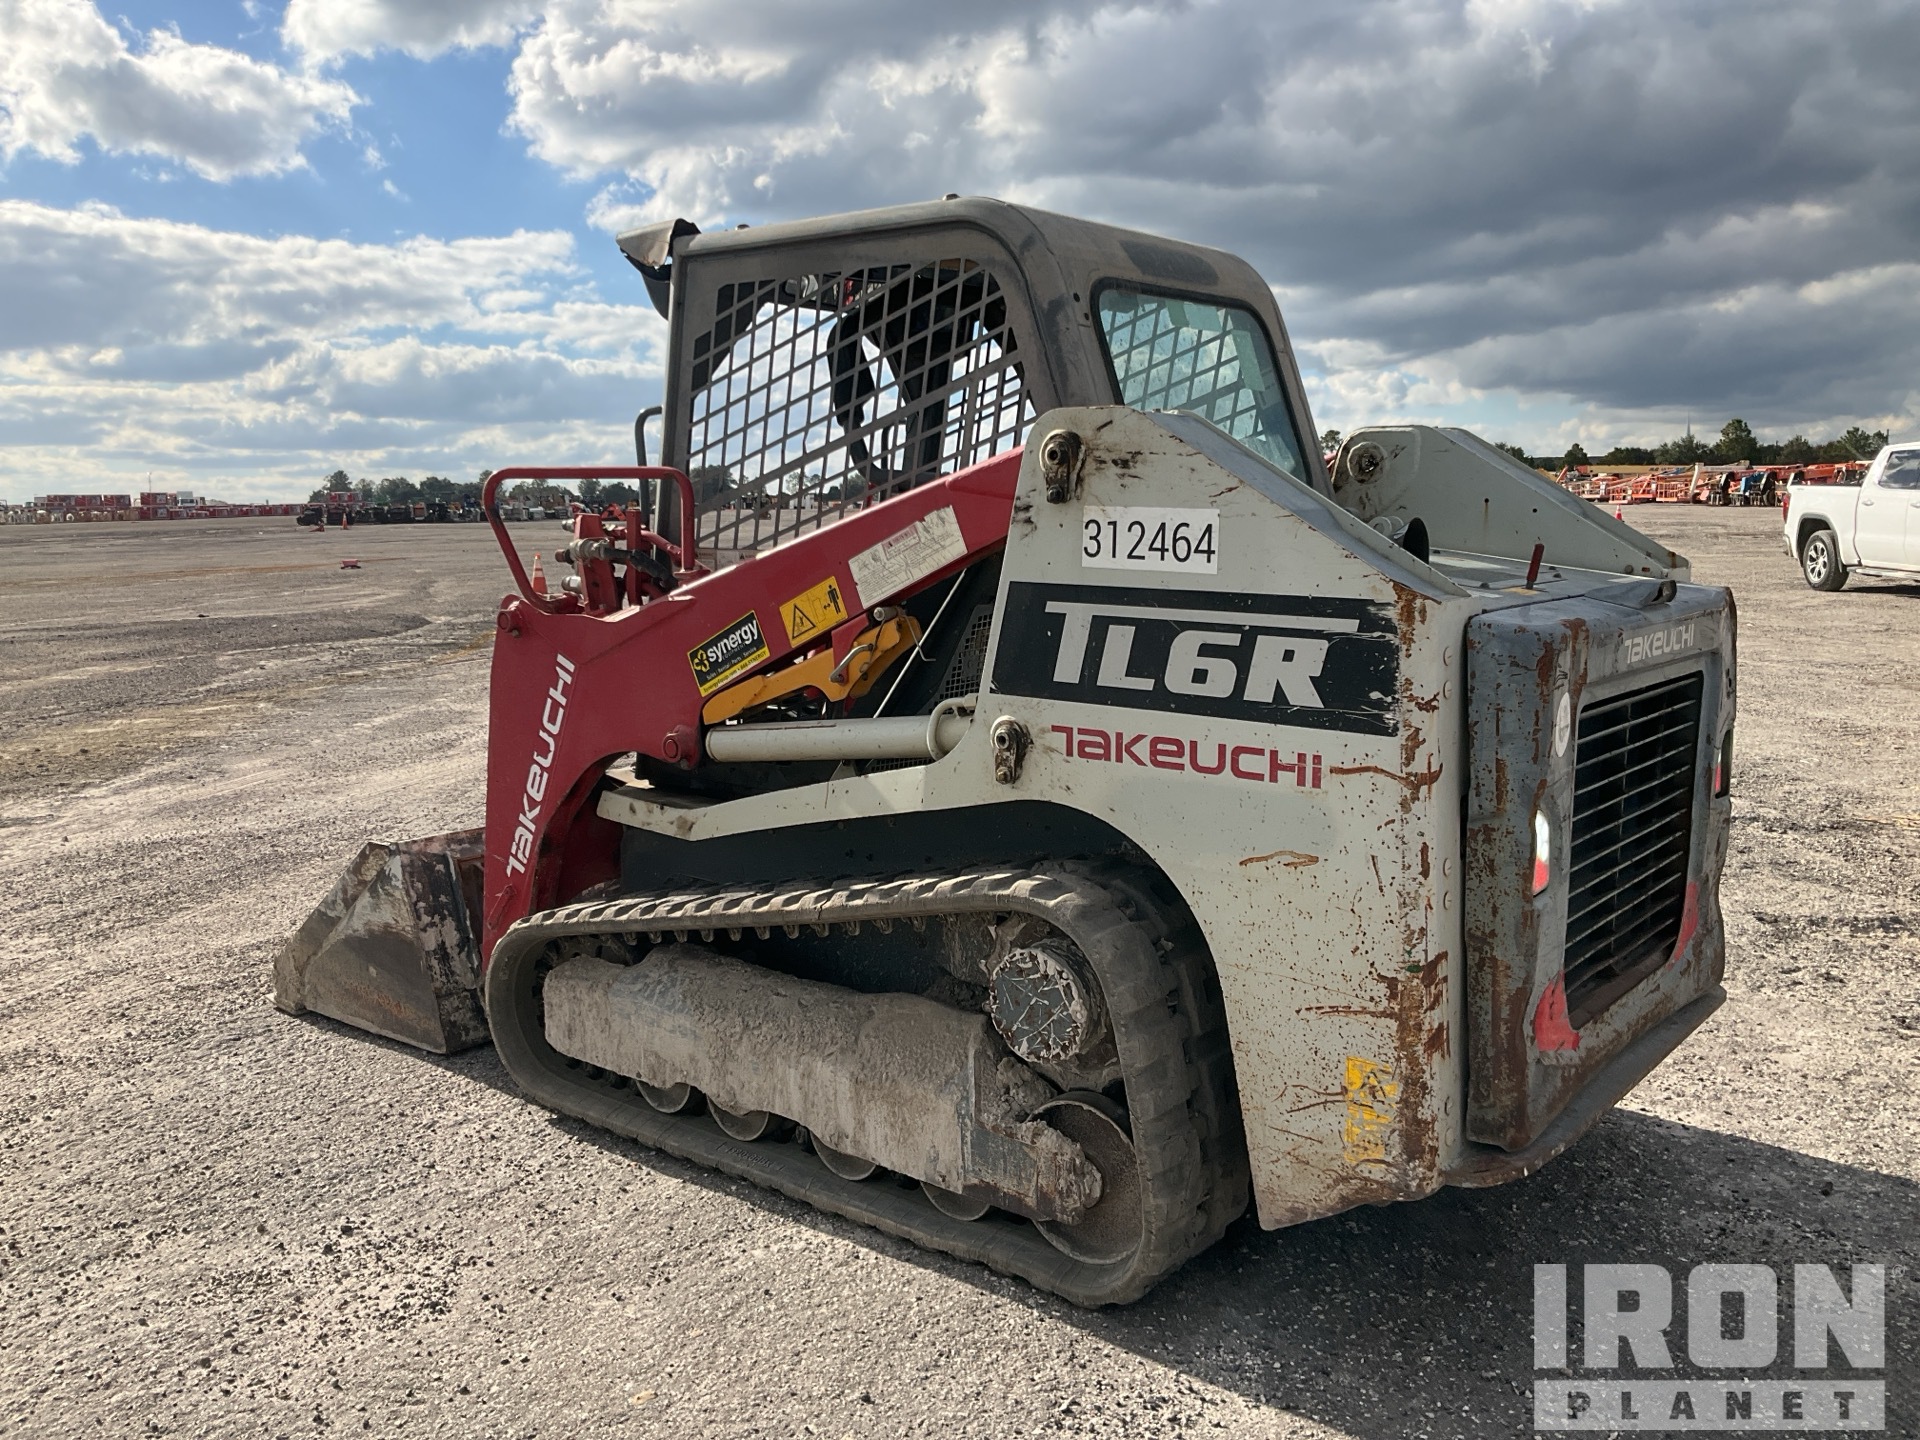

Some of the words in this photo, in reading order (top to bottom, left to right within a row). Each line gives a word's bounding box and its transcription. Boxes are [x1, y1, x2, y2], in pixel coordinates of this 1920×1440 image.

[1083, 518, 1216, 564] 312464
[707, 620, 758, 662] synergy
[1045, 601, 1360, 708] TL6R
[1624, 623, 1695, 664] TAKEUCHI
[507, 653, 576, 877] TAKEUCHI
[1050, 724, 1322, 789] TAKEUCHI
